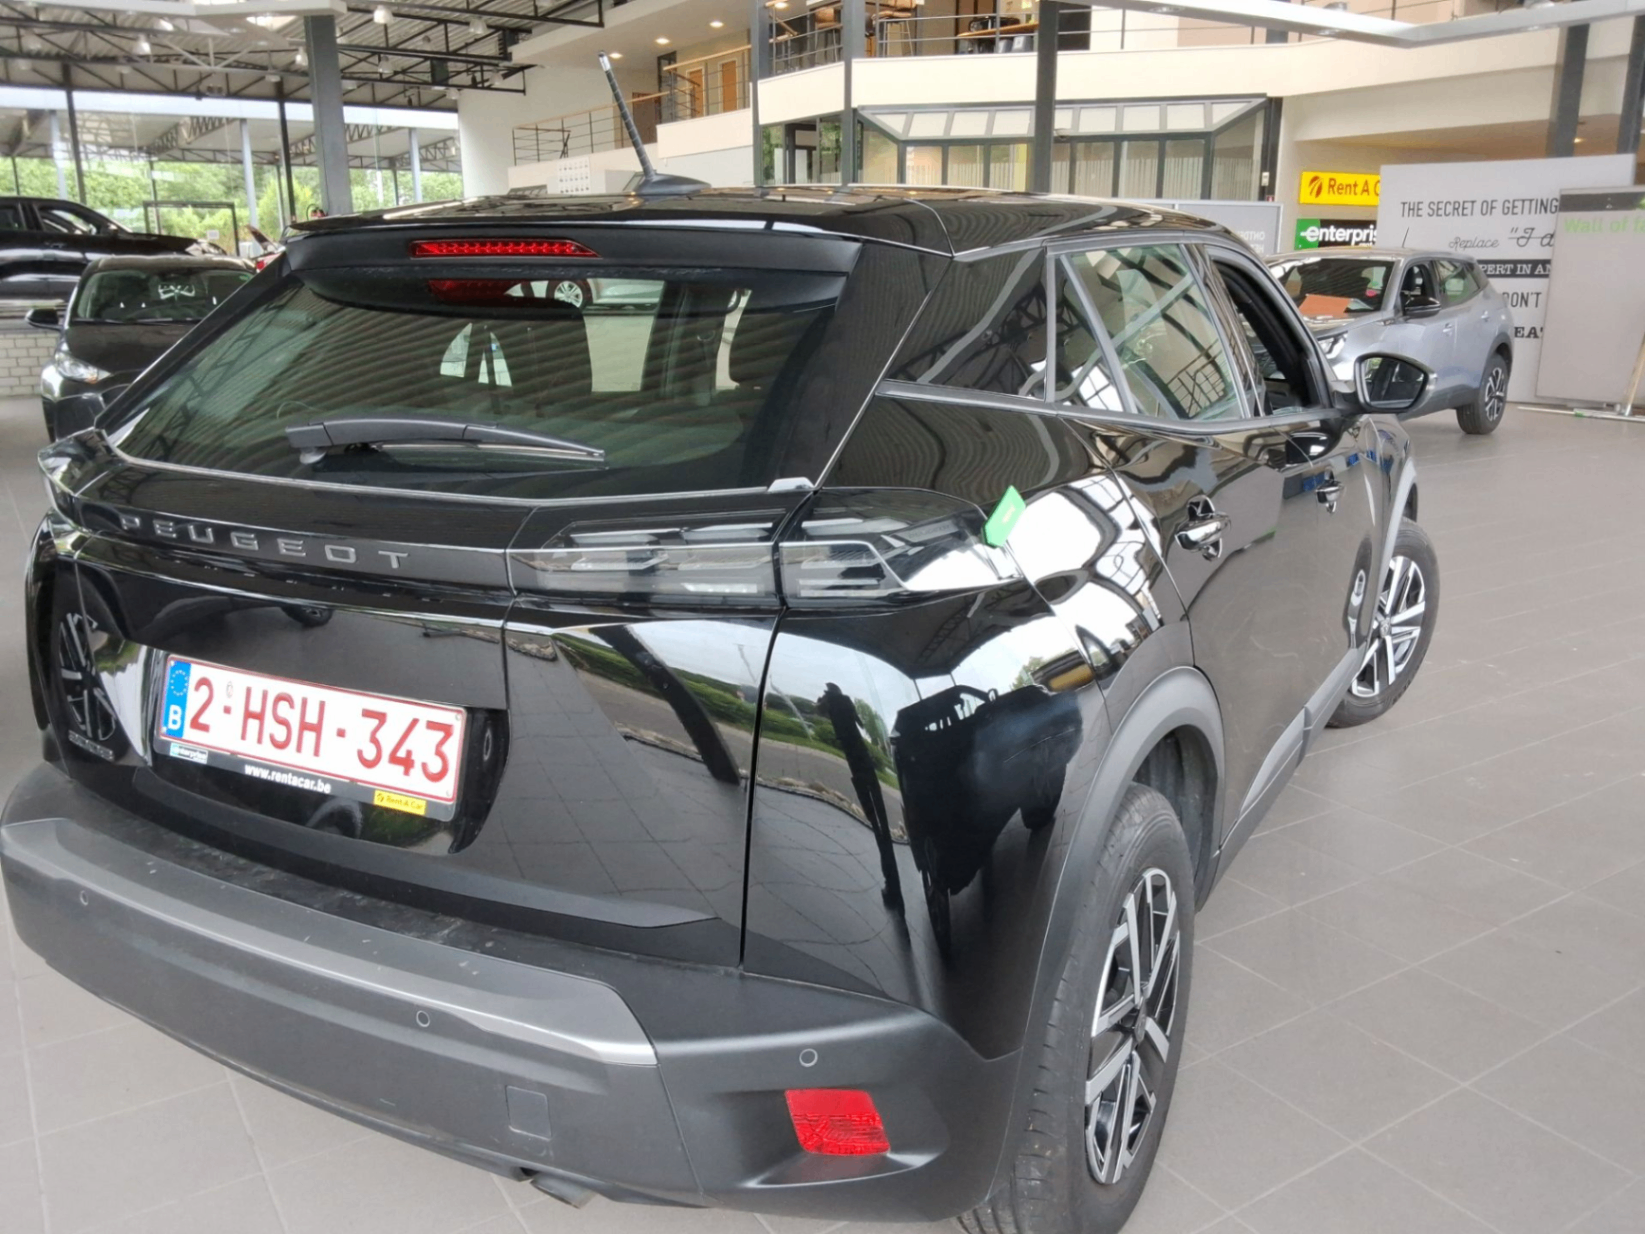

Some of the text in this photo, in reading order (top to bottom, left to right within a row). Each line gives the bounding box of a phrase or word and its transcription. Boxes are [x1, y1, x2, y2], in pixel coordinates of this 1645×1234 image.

[1327, 177, 1358, 196] Rent
[1360, 179, 1370, 196] A
[1401, 197, 1559, 218] THE SECRET OF GETTING
[1564, 216, 1602, 233] Wall
[1610, 216, 1629, 233] of
[1448, 236, 1499, 251] Replace
[1515, 264, 1532, 275] IN
[1514, 326, 1543, 339] EA
[121, 516, 409, 569] PEUGEOT
[168, 676, 455, 783] B 2-HSH-343
[244, 764, 332, 794] www.rentacar.be
